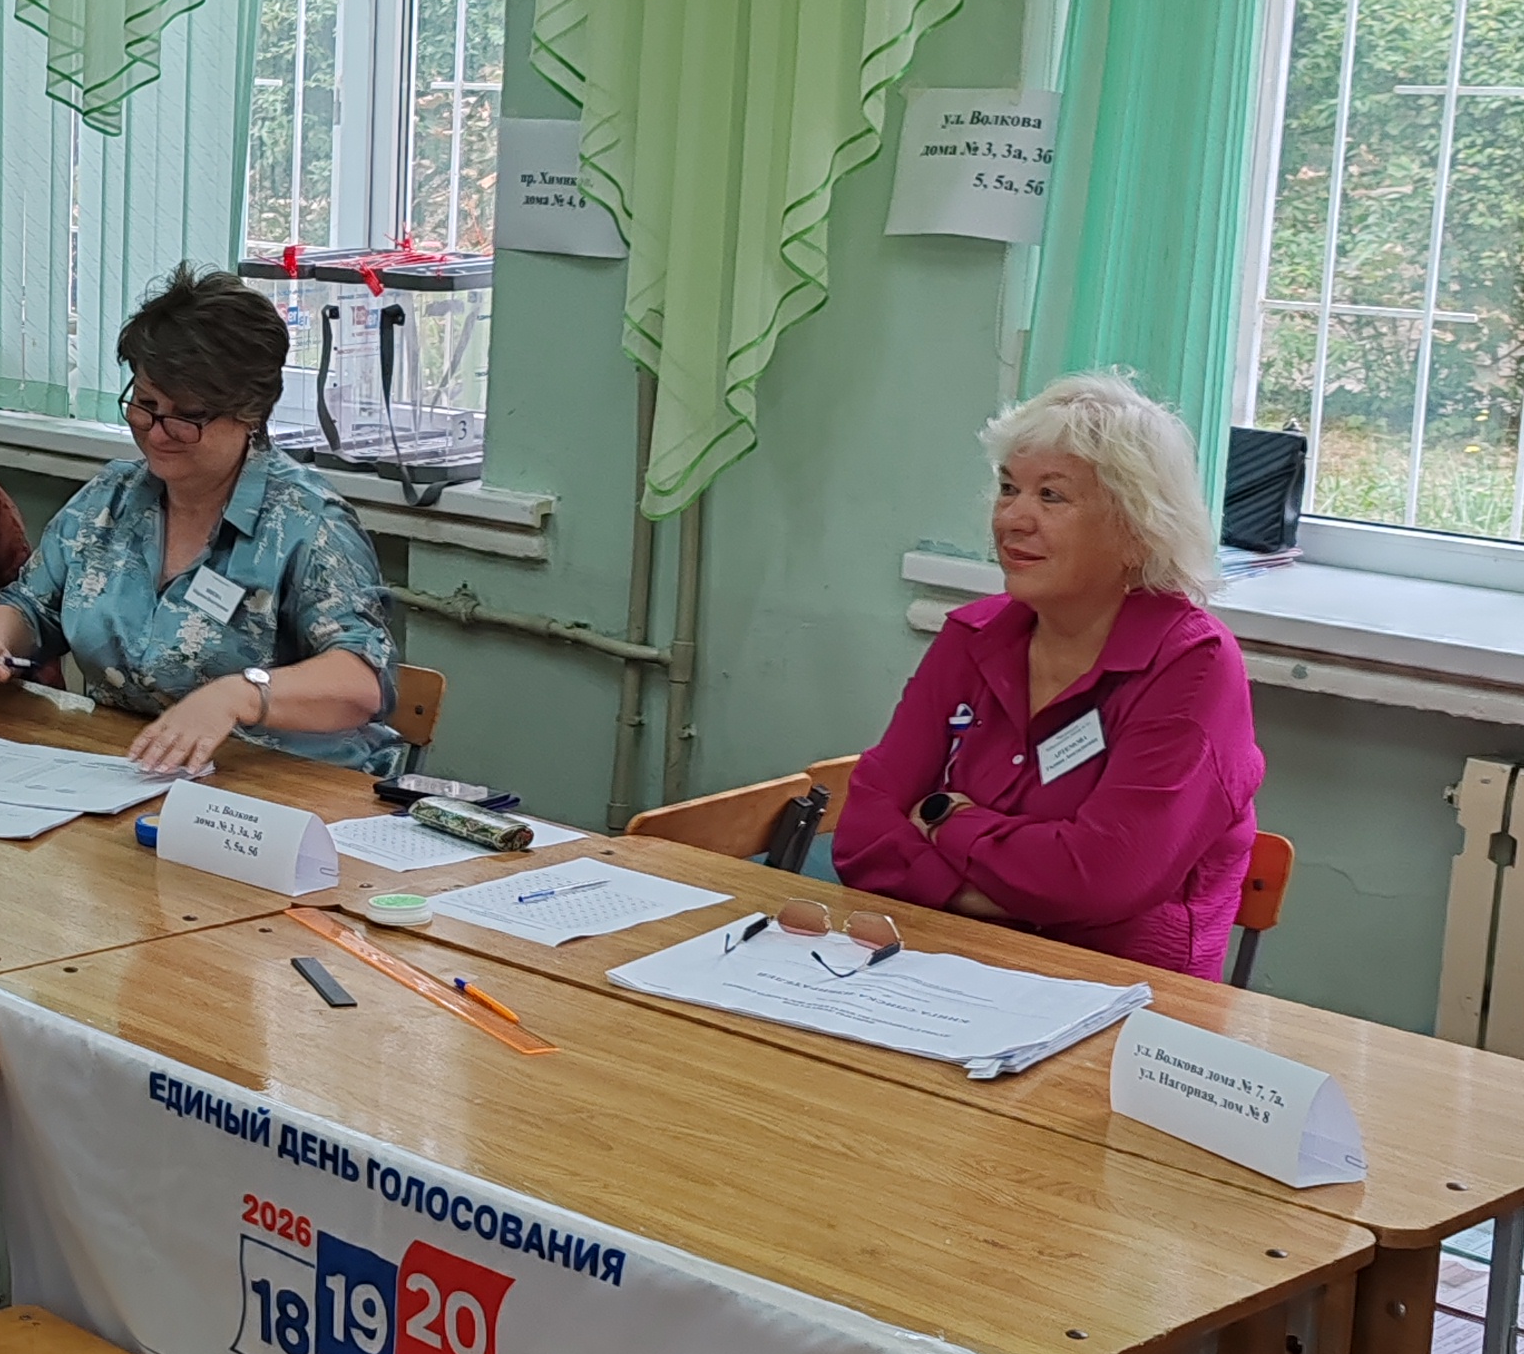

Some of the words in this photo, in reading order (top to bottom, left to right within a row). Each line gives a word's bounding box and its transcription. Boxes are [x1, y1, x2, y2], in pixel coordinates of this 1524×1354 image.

[941, 113, 965, 129] ул.
[969, 110, 1042, 129] Волкова
[919, 145, 957, 157] дома
[982, 142, 997, 158] 3,
[1001, 144, 1028, 162] 3а,
[1032, 148, 1054, 164] 3б
[520, 174, 536, 187] пр.
[972, 173, 988, 189] 5,
[993, 175, 1019, 193] 5а,
[1023, 179, 1044, 196] 5б
[522, 195, 549, 205] дома
[567, 195, 576, 208] 4,
[579, 195, 586, 208] 6
[458, 420, 467, 440] 3
[194, 816, 215, 828] дома
[222, 805, 259, 823] Волкова
[1133, 1044, 1152, 1057] ул.
[1155, 1047, 1204, 1077] Волкова
[1205, 1069, 1236, 1088] дома
[1256, 1085, 1266, 1100] 7,
[1138, 1067, 1156, 1081] ул.
[1158, 1071, 1218, 1106] Нагорная,
[1219, 1098, 1244, 1115] дом
[1262, 1110, 1271, 1124] 8
[149, 1070, 271, 1147] ЕДИНЫЙ
[277, 1124, 359, 1183] ДЕНЬ
[366, 1156, 626, 1288] ГОЛОСОВАНИЯ
[242, 1193, 312, 1247] 2026
[325, 1272, 388, 1354] 19
